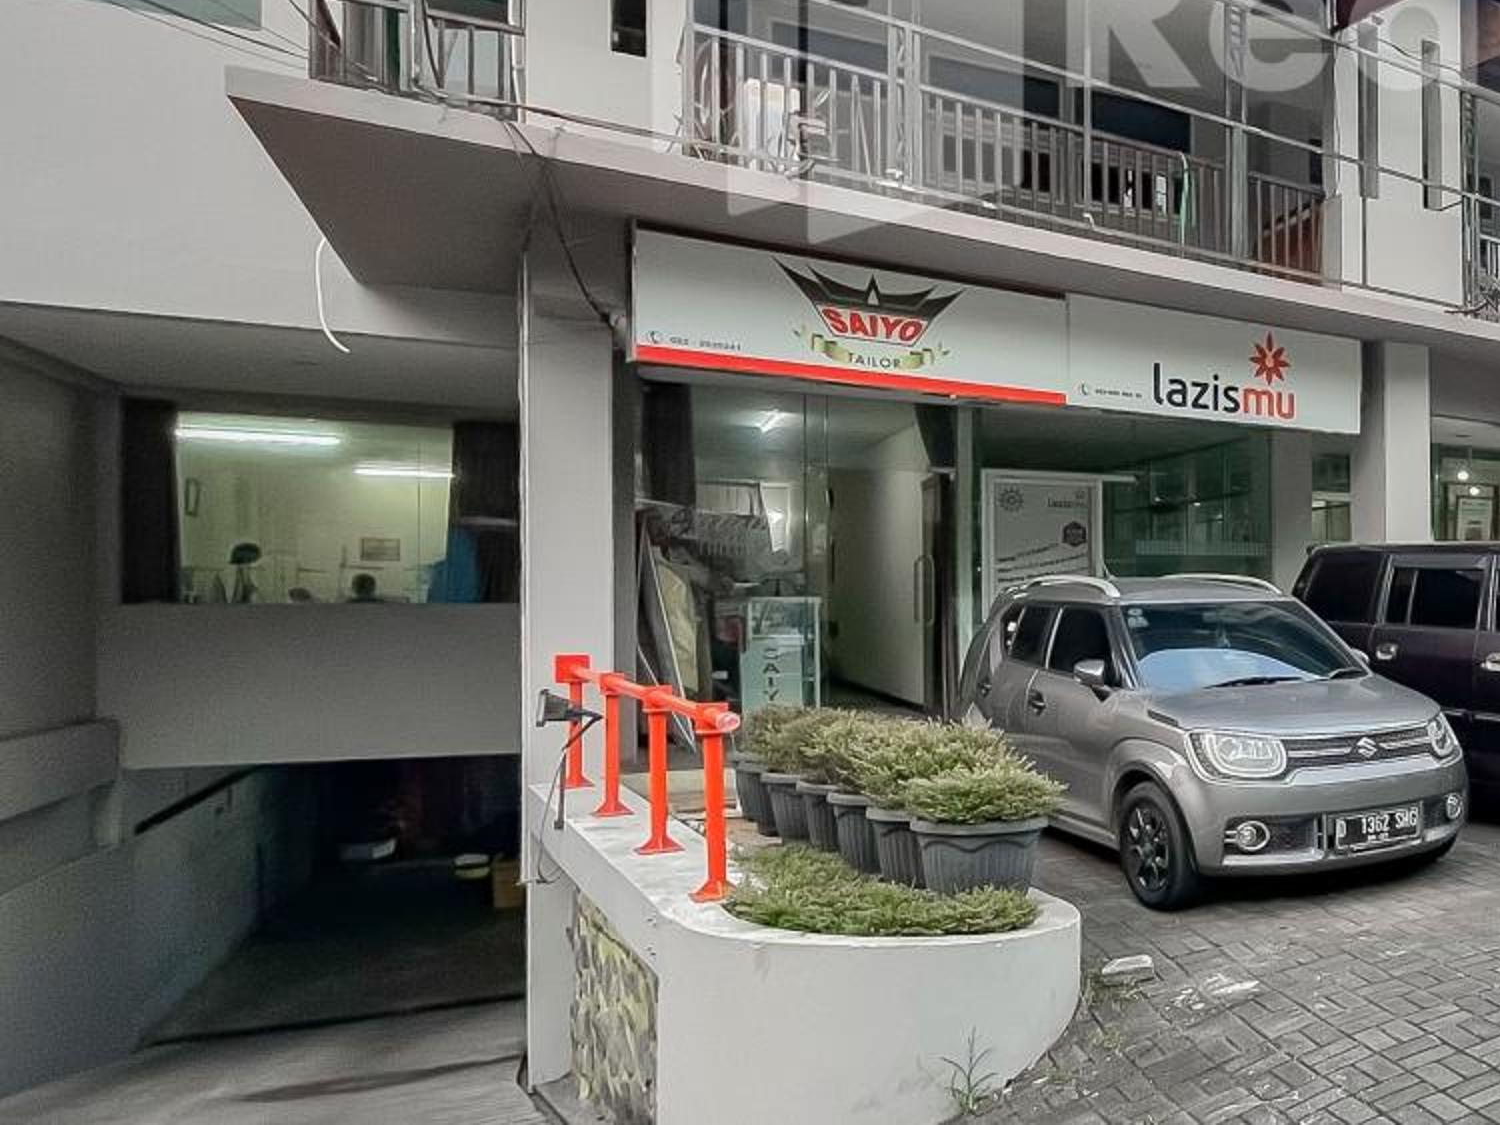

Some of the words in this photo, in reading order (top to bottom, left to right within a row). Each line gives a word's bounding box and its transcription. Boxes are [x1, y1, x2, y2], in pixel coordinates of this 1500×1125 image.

[822, 307, 925, 342] SAIYO
[848, 351, 901, 370] TAILOR
[1152, 362, 1297, 420] lazismu
[1361, 813, 1390, 834] 1362
